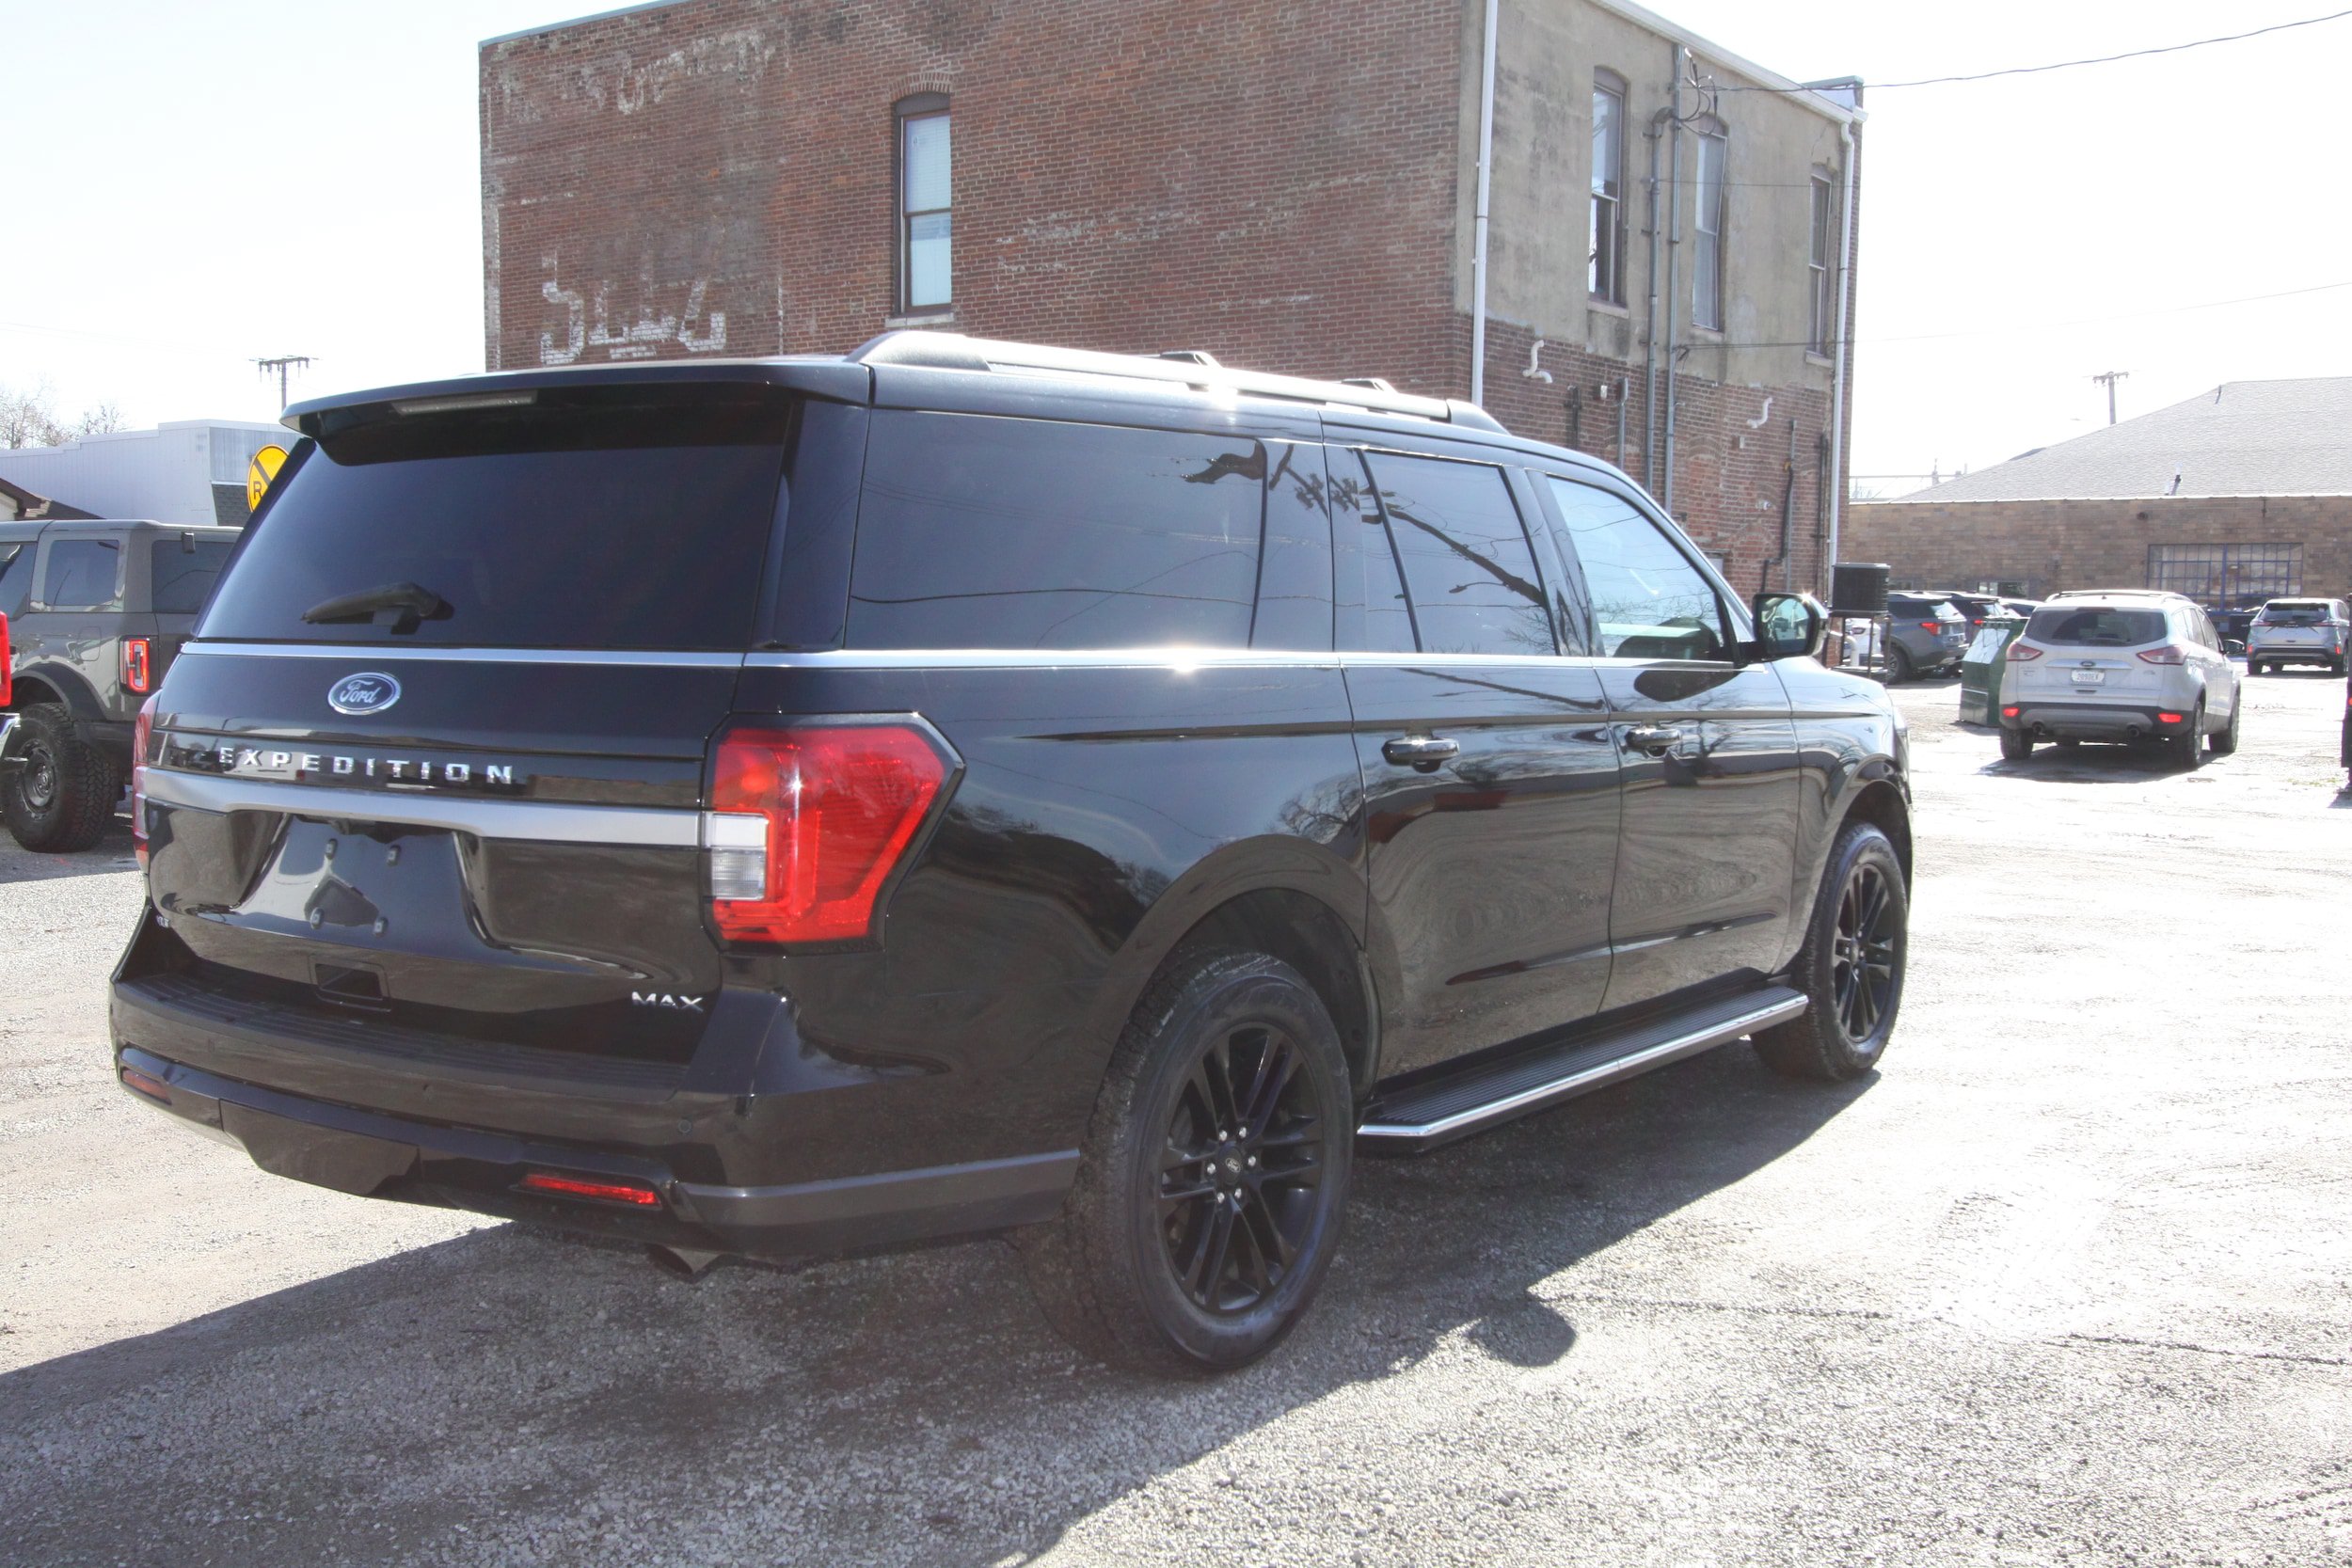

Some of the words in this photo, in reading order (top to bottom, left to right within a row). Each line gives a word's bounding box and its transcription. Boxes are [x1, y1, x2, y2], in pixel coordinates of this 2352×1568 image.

[253, 481, 262, 500] R
[340, 679, 382, 704] Ford
[219, 747, 513, 784] EXPEDITION
[631, 990, 704, 1013] MAX
